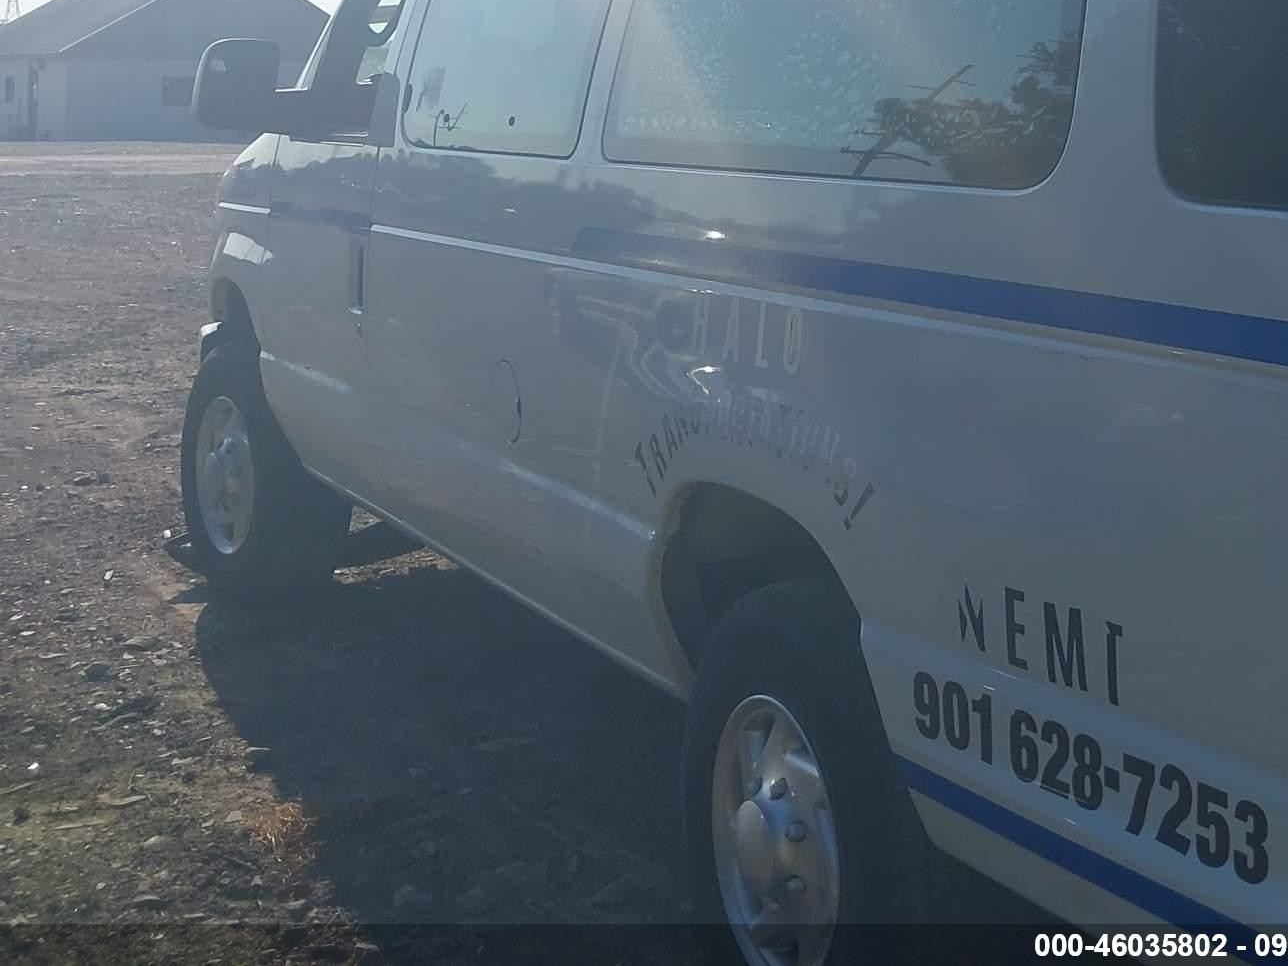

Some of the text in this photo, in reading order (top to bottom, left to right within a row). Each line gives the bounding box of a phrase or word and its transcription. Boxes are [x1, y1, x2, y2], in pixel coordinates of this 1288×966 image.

[689, 296, 803, 375] HALO
[958, 583, 1124, 707] NEMT
[913, 671, 1270, 885] 901 628-7253
